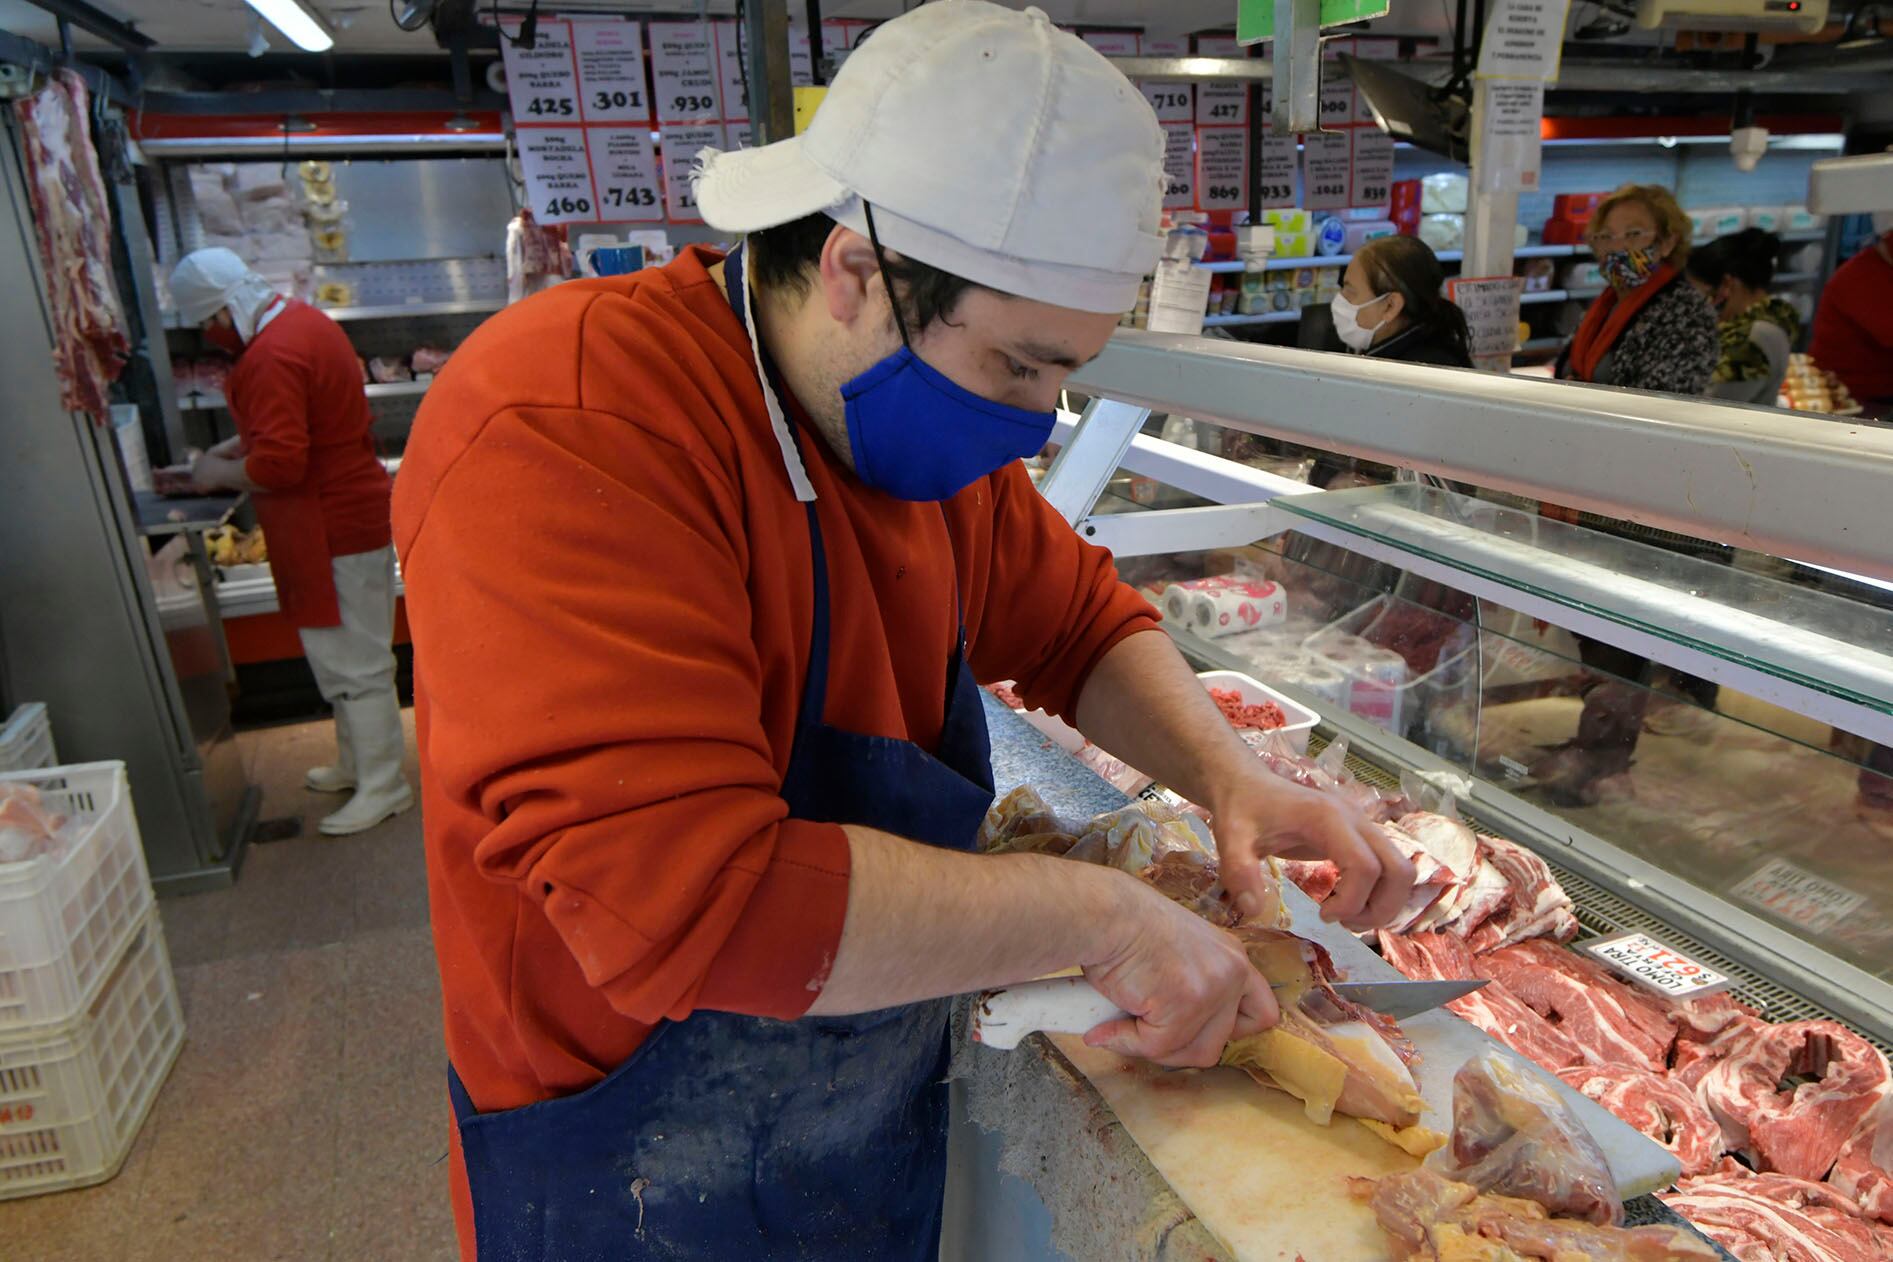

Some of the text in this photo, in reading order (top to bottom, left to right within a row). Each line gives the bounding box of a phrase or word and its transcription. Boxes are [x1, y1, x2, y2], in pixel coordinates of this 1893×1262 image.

[545, 196, 591, 216] 460
[1603, 947, 1683, 990] LOMO TIRA
